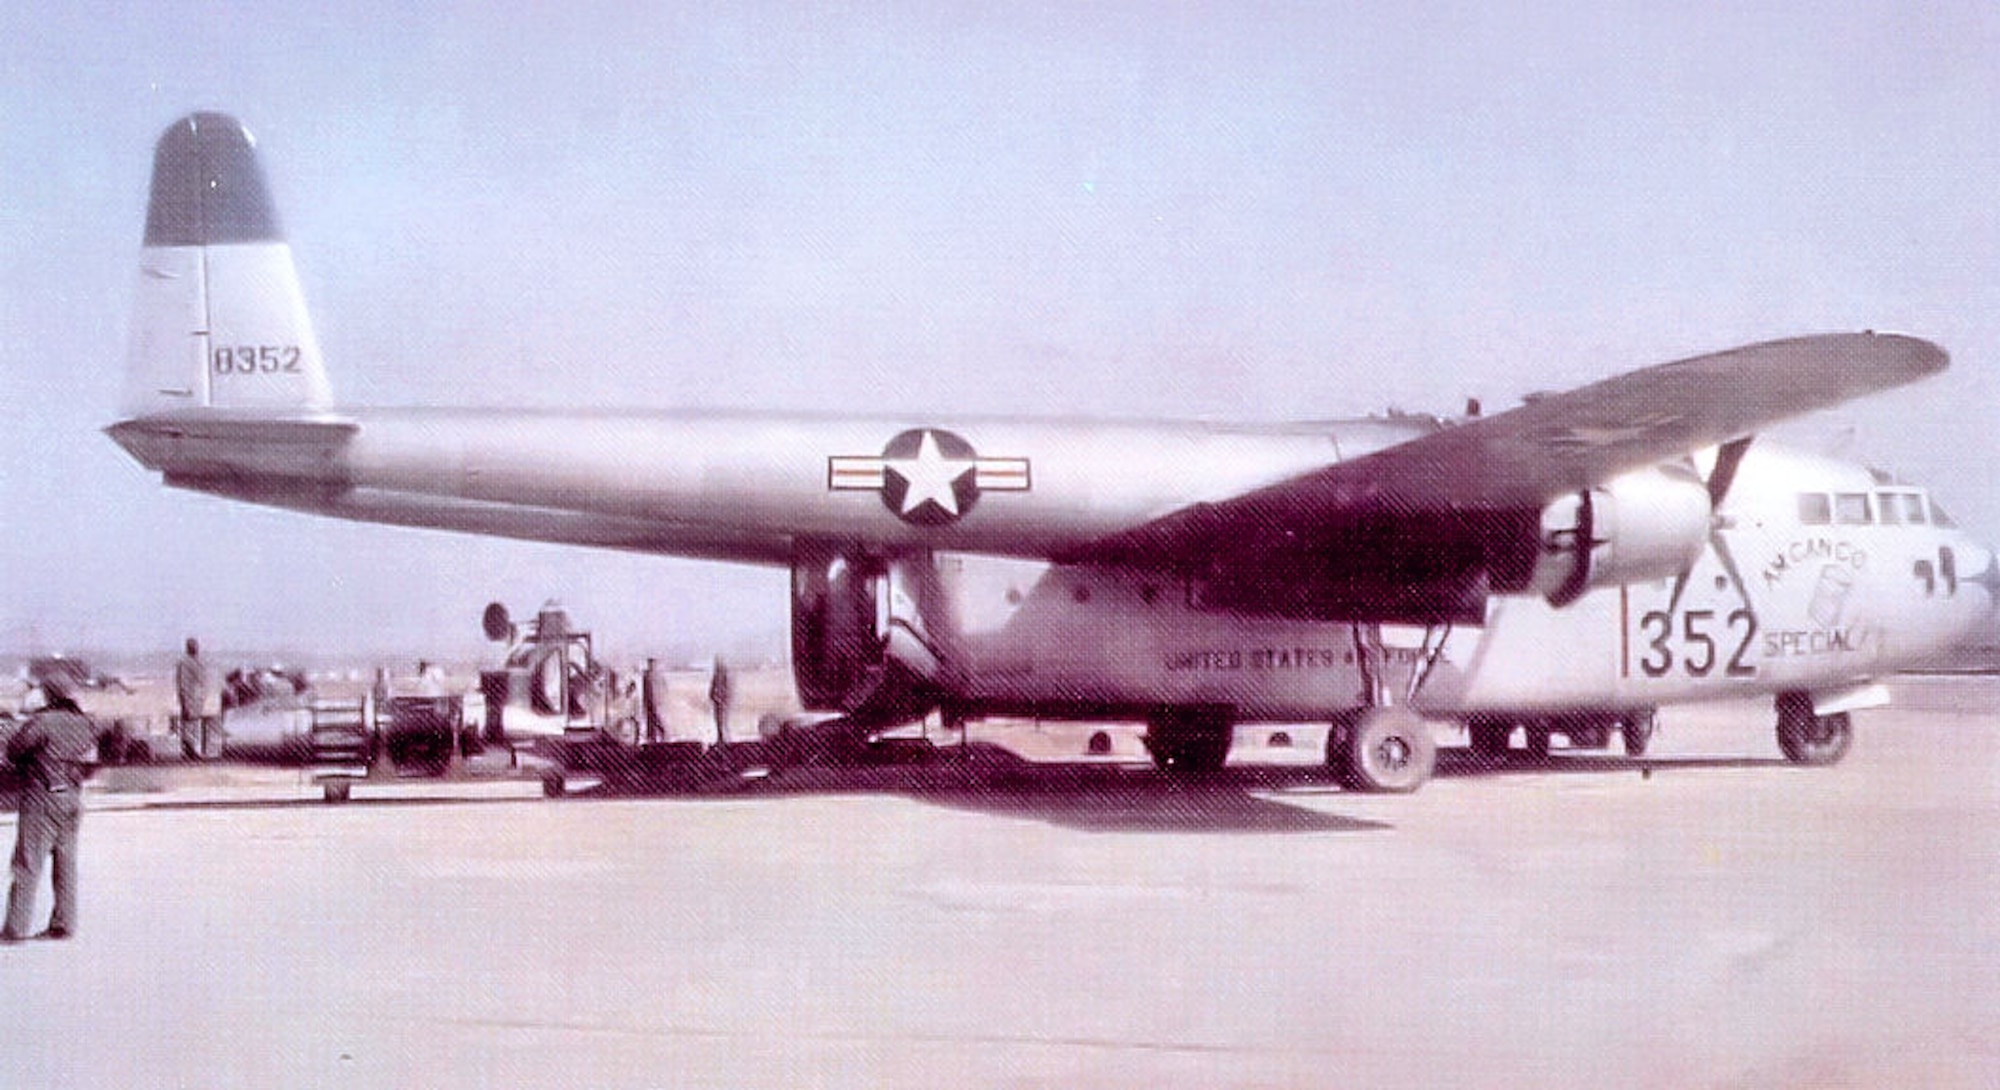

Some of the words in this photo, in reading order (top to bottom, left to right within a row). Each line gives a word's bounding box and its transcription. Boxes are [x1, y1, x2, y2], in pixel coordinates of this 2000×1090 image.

[1641, 610, 1757, 678] 352
[1763, 630, 1856, 657] SPECIAL
[1167, 650, 1241, 671] UNITED
[1253, 649, 1332, 668] STATES
